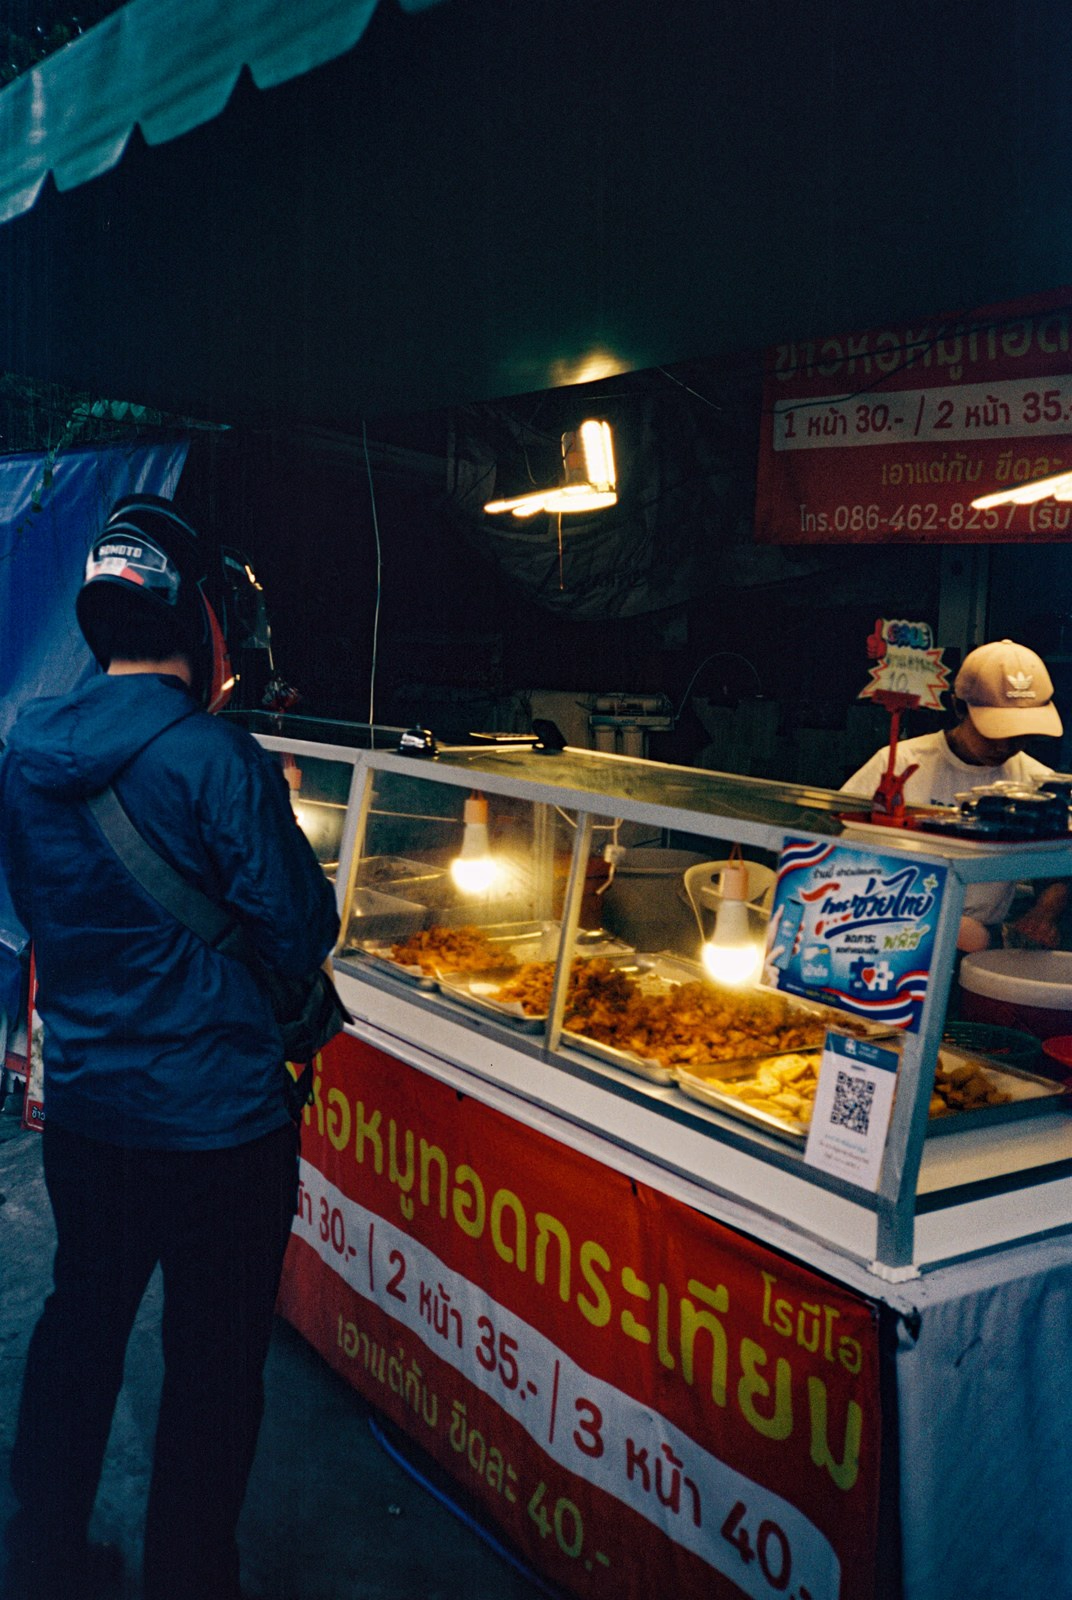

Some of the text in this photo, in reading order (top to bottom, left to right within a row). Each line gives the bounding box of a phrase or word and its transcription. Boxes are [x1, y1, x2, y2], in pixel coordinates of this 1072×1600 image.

[784, 411, 796, 438] 1
[807, 407, 848, 437] หน้า
[855, 404, 904, 433] 30.-
[933, 400, 955, 430] 2
[964, 395, 1010, 428] หน้า
[286, 1052, 862, 1491] ห่อหมูทอดกระเทียม
[386, 1250, 408, 1303] 2
[419, 1281, 463, 1349] หน้า
[475, 1315, 538, 1400] 35.-
[573, 1397, 604, 1458] 3
[626, 1438, 702, 1528] หน้า
[336, 1313, 610, 1571] เอาแต่กับ ขีดละ 40.-
